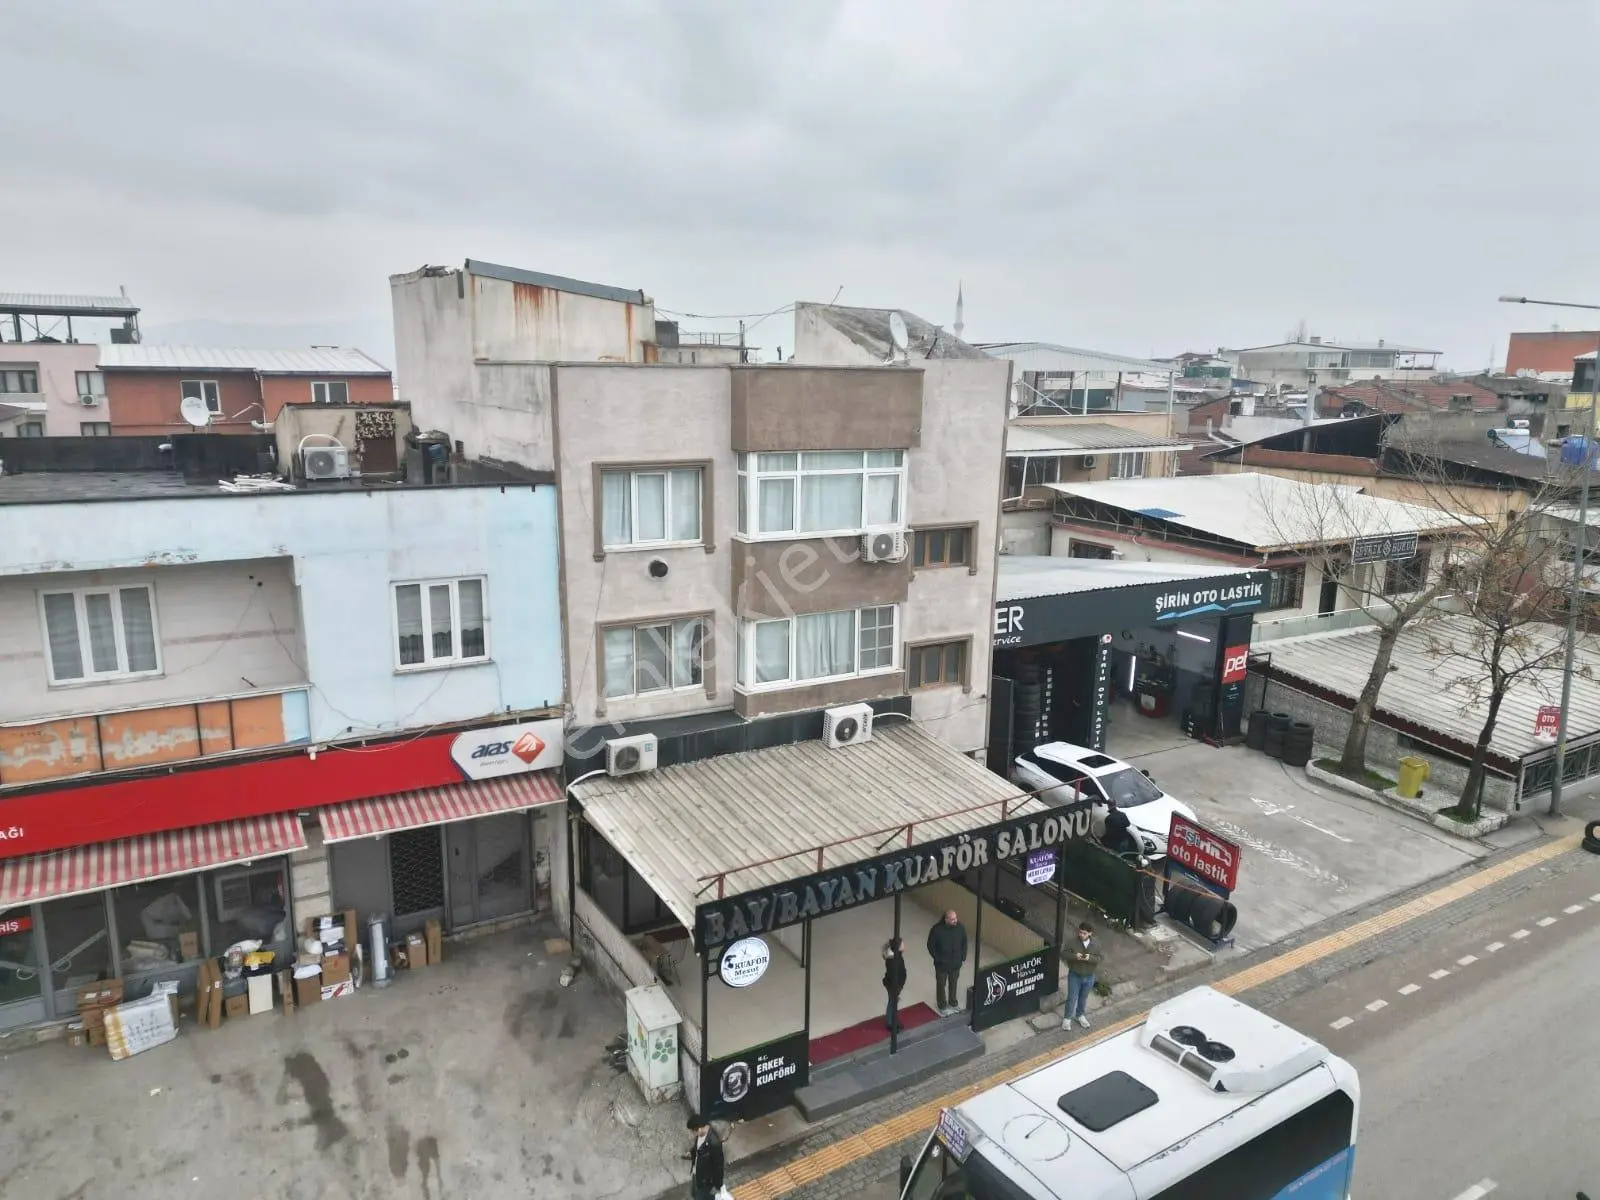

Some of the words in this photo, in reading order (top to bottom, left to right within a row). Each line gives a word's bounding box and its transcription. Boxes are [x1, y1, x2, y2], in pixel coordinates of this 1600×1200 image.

[1155, 591, 1190, 613] ŞİRİN
[1193, 589, 1218, 605] OTO
[1220, 581, 1264, 601] LASTİK
[1097, 686, 1105, 706] OTO
[1541, 714, 1556, 724] OTO
[471, 740, 515, 759] aras
[1171, 844, 1191, 862] oto
[1193, 852, 1228, 885] lastik
[704, 867, 879, 945] BAY/BAYAN
[883, 834, 989, 895] KUAFÖR
[997, 808, 1093, 860] SALONU
[1010, 956, 1042, 975] KUAFÖR
[1023, 972, 1045, 986] KUAFÖR
[1015, 983, 1036, 997] SALONU
[756, 1055, 784, 1074] ERKEK
[756, 1062, 797, 1088] KUAFÖRÜ
